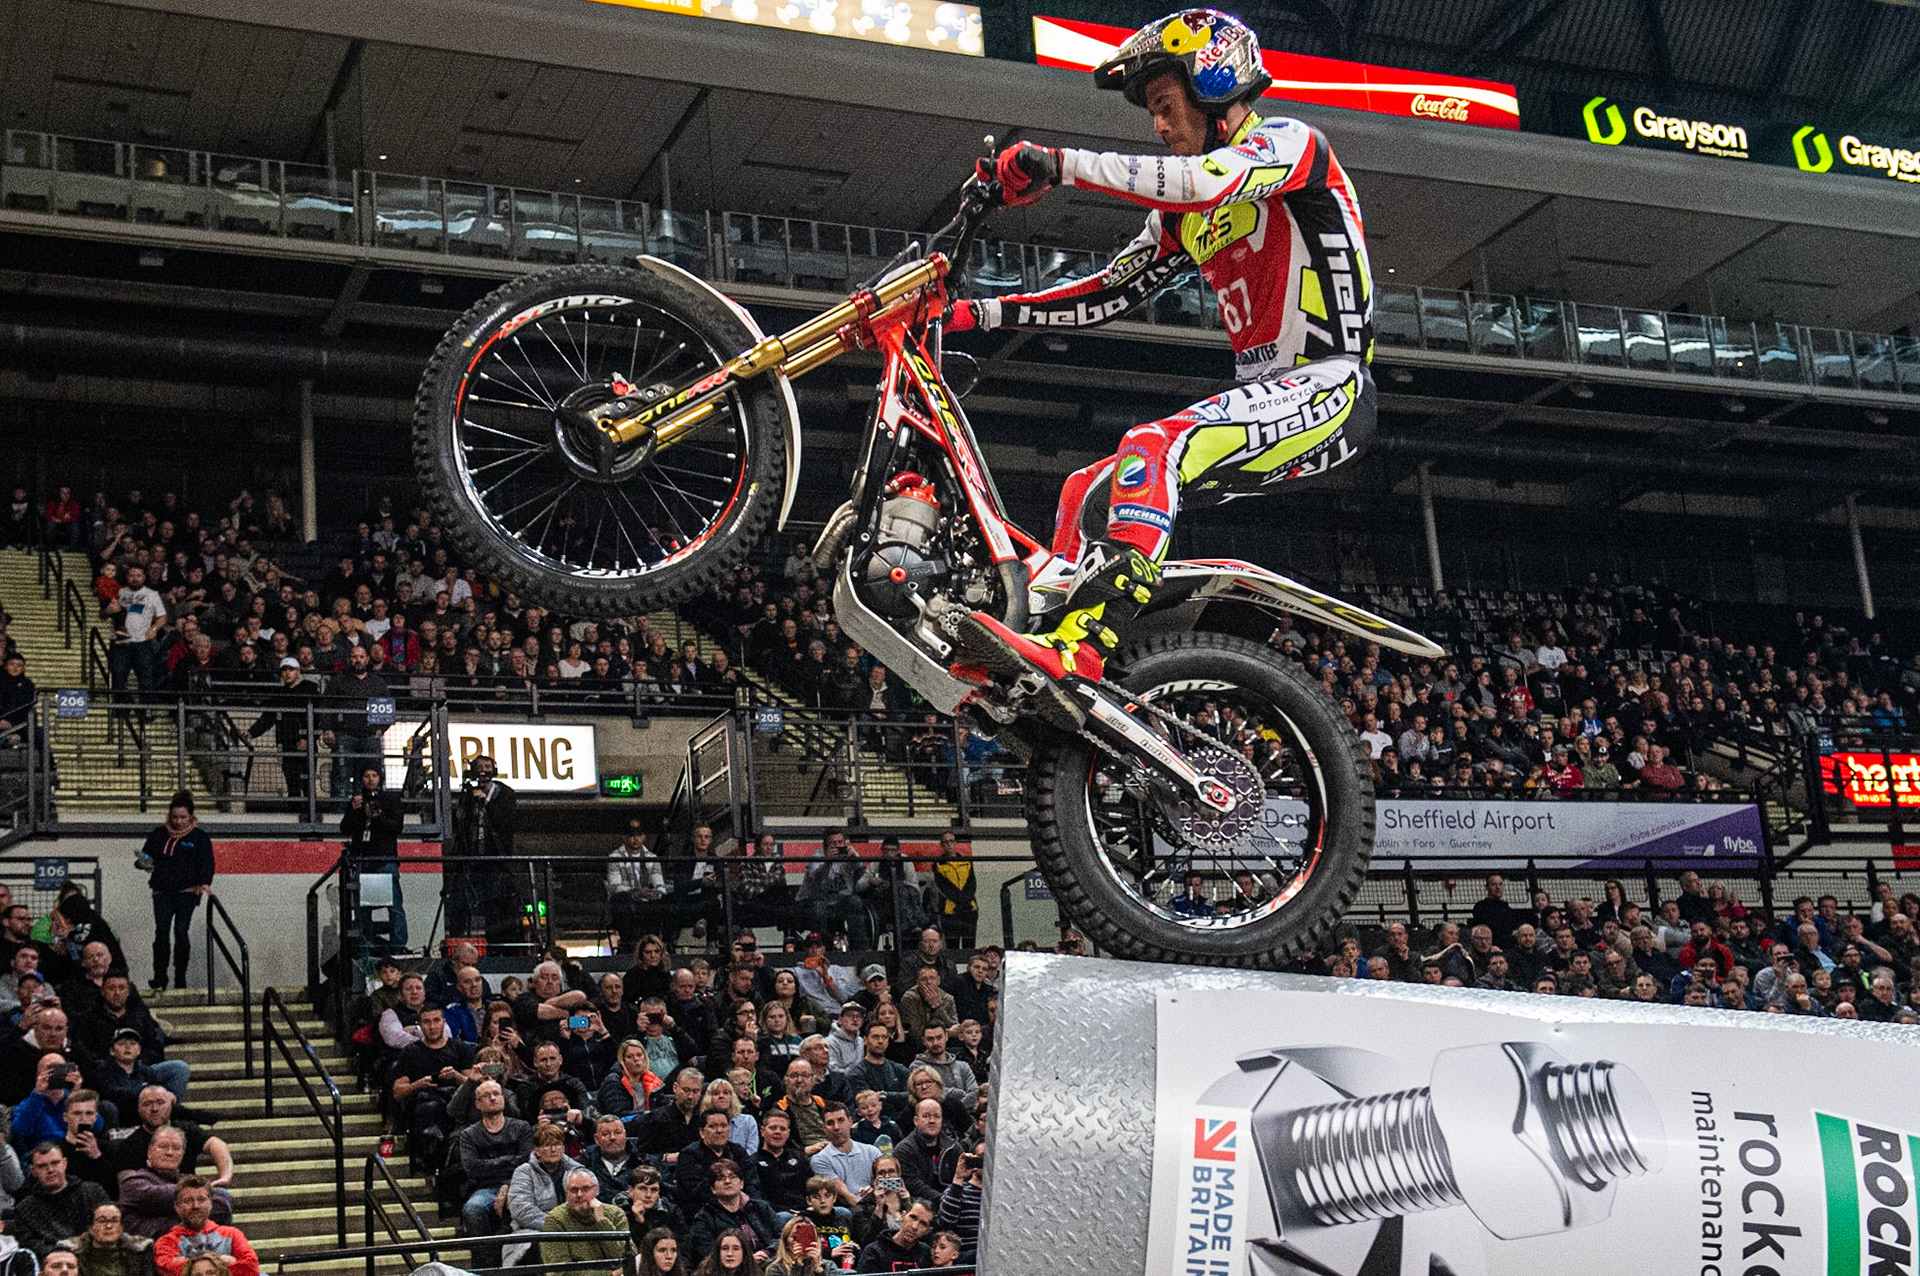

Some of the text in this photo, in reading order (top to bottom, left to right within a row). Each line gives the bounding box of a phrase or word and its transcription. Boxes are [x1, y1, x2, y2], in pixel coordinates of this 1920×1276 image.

[1633, 106, 1748, 150] Grayson
[1018, 295, 1130, 326] hebo
[1217, 276, 1252, 334] 67
[1247, 387, 1348, 451] hebo
[1118, 507, 1171, 528] MICHELIN
[60, 696, 85, 707] 206
[371, 703, 393, 714] 205
[760, 713, 780, 723] 205
[1384, 809, 1475, 829] Sheffield
[1483, 811, 1555, 835] Airport
[1449, 839, 1493, 850] Guernsey
[38, 866, 66, 877] 106
[1211, 1167, 1236, 1252] MADE
